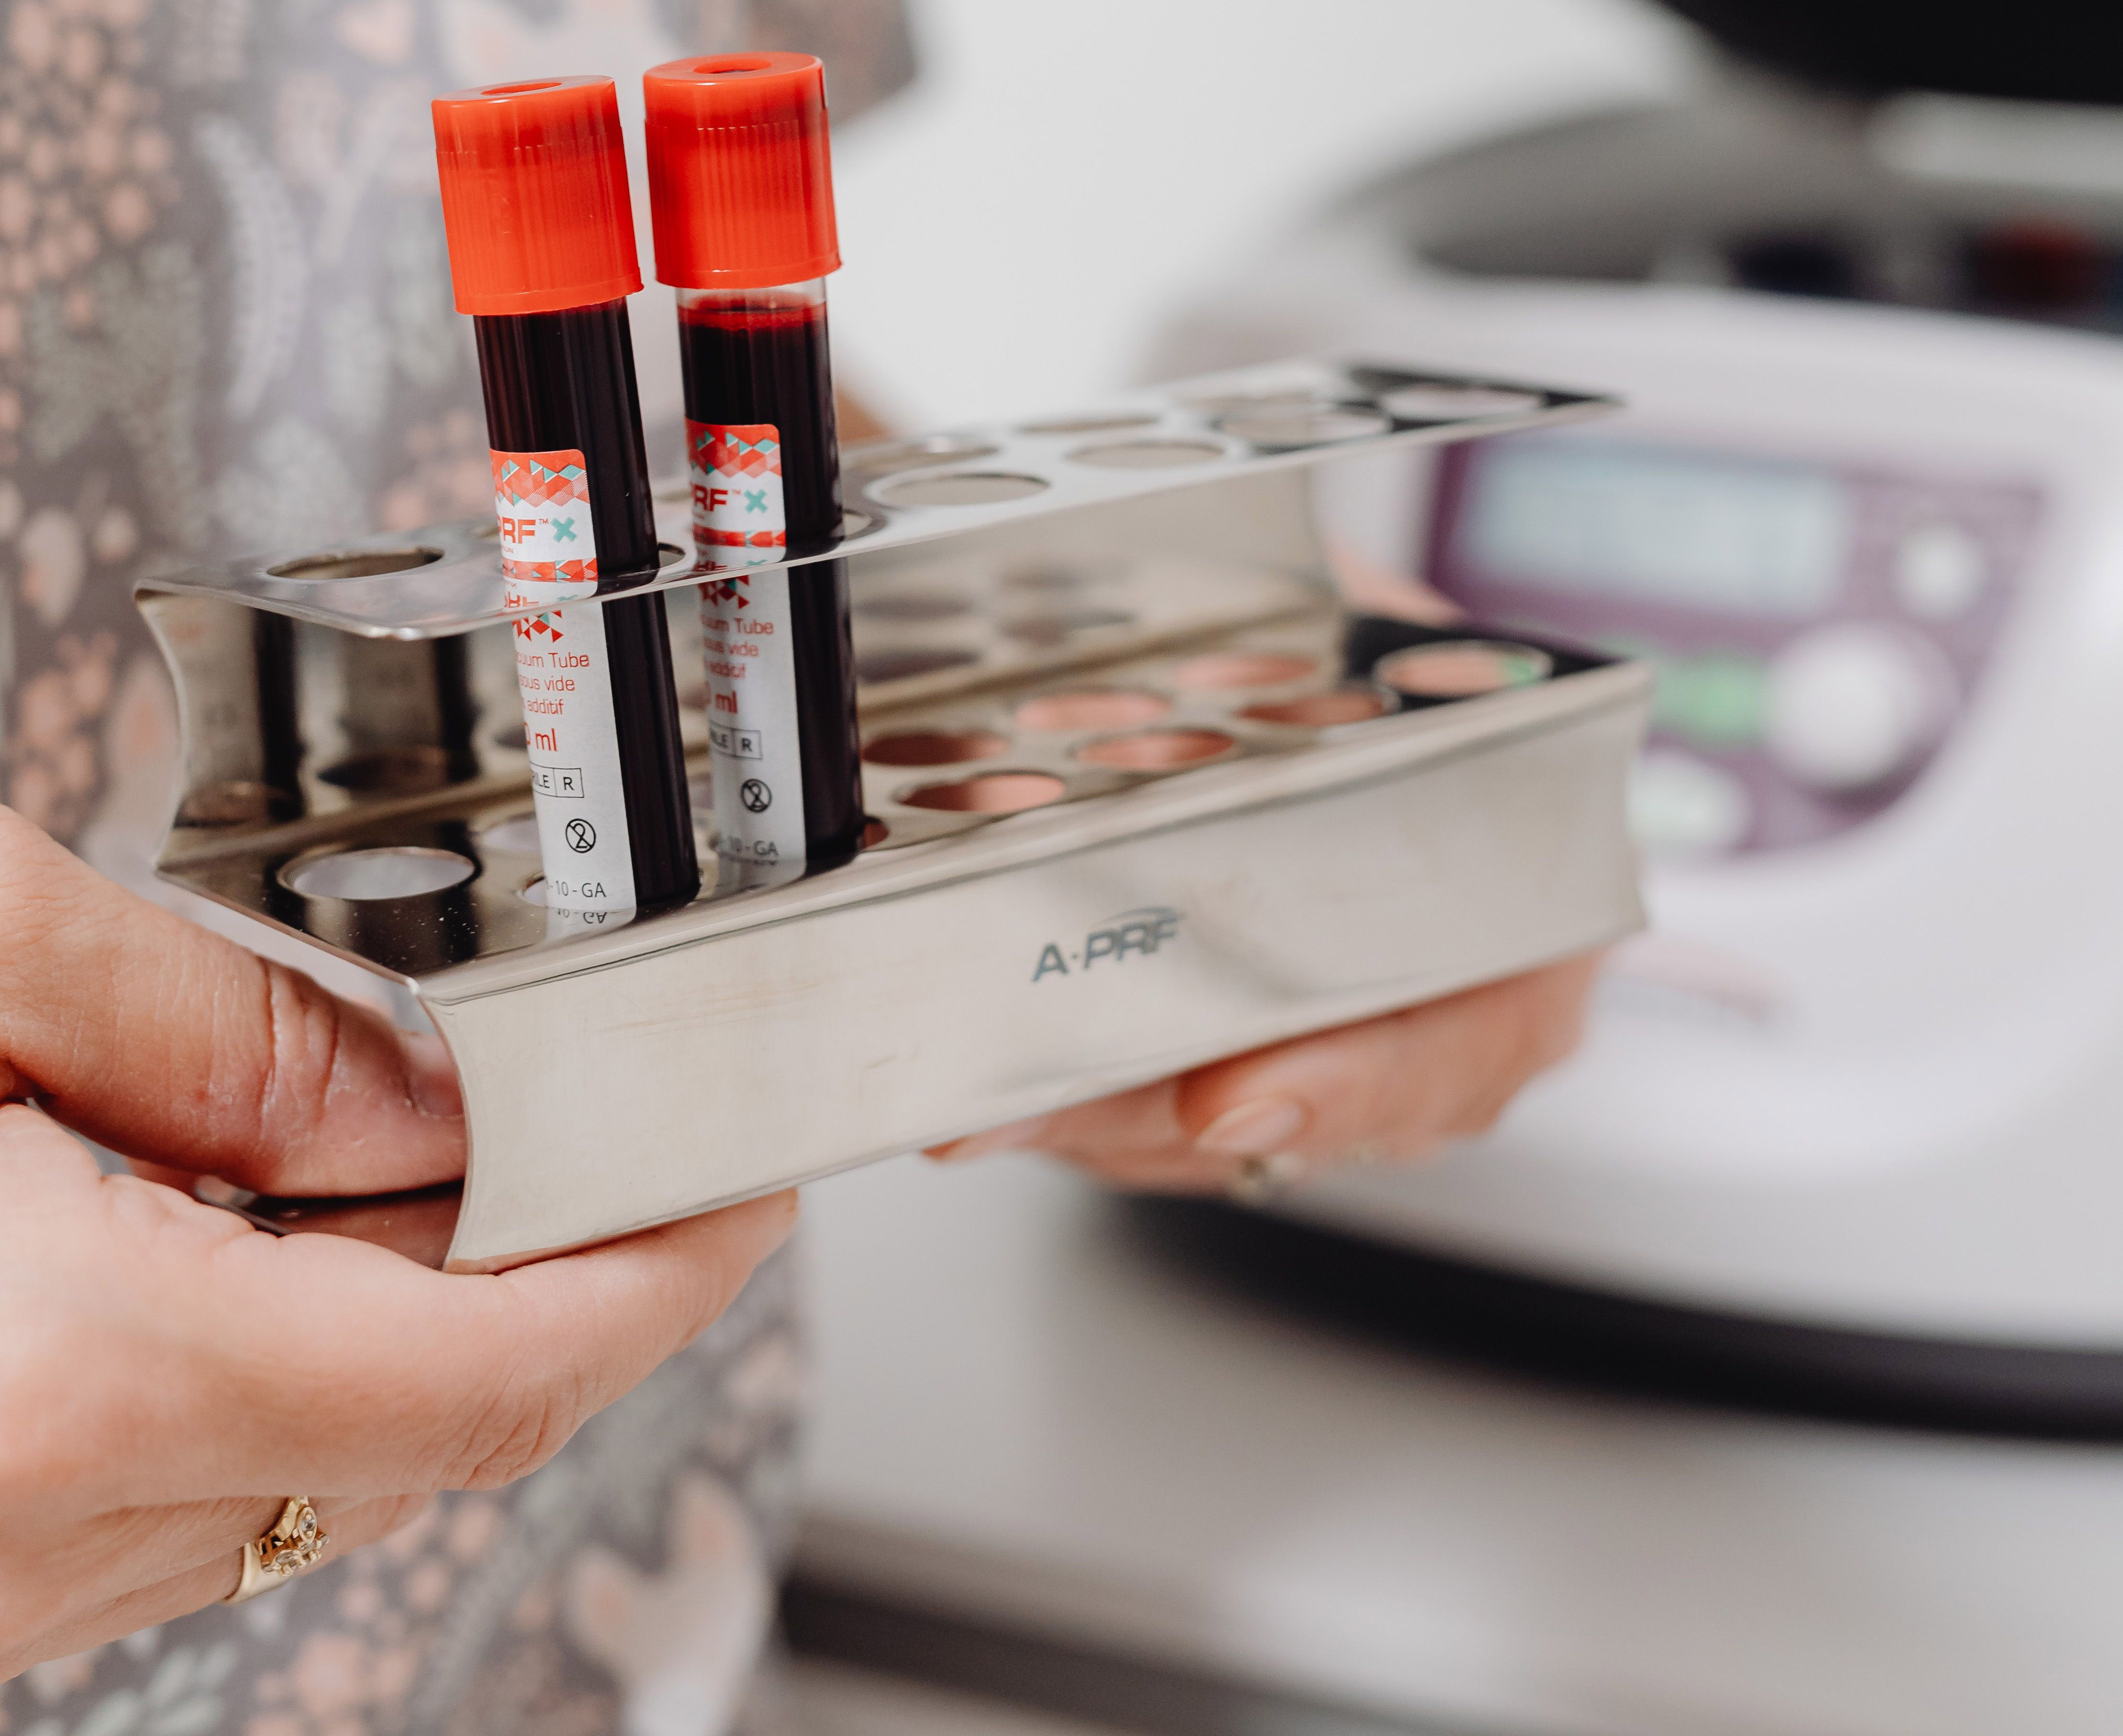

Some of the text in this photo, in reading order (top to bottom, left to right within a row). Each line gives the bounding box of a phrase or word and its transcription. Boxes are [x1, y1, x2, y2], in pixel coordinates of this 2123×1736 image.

[734, 618, 774, 635] Tube
[548, 652, 589, 668] Tube
[544, 675, 575, 691] vide
[528, 698, 564, 715] additif
[535, 728, 557, 751] ml
[741, 737, 752, 752] R
[563, 777, 575, 791] R
